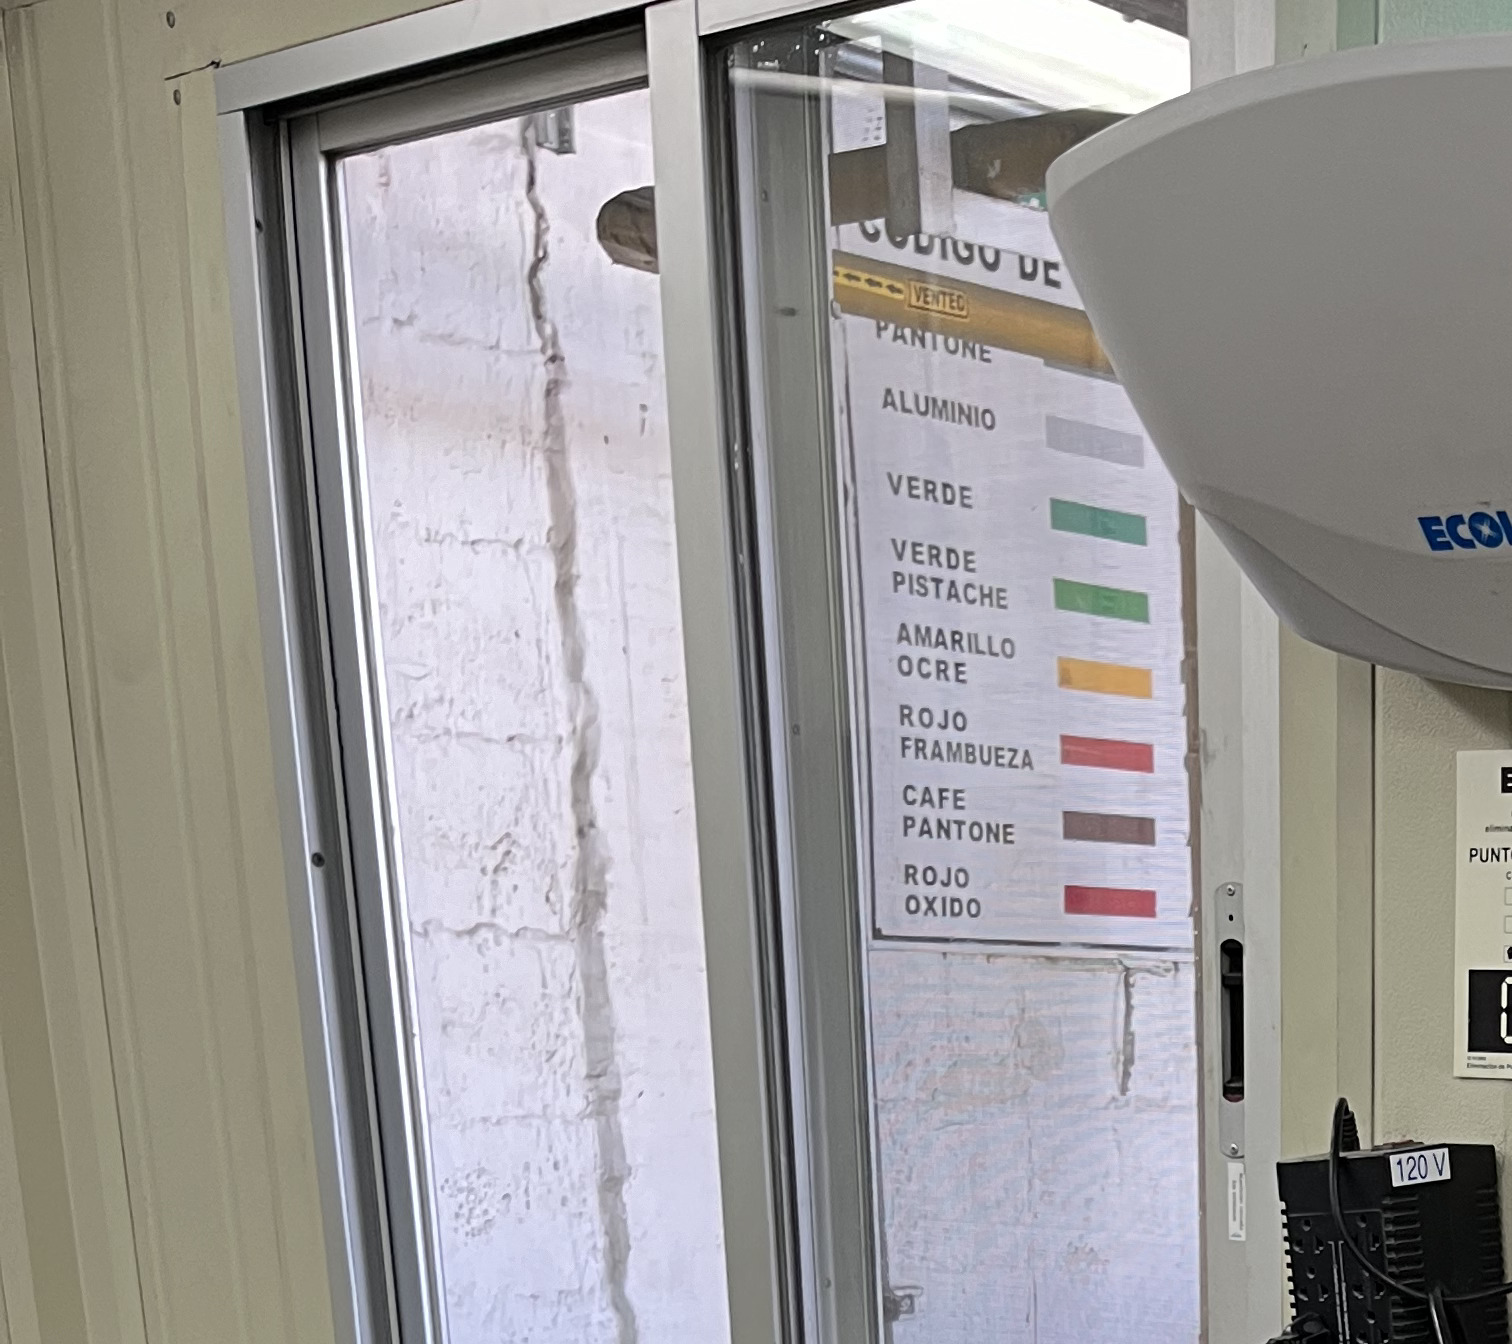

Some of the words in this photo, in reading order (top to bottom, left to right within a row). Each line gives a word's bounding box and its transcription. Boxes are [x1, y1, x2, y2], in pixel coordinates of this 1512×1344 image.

[881, 387, 997, 432] ALUMINIO
[886, 472, 974, 510] VERDE
[890, 537, 978, 574] VERDE
[892, 570, 1009, 610] PISTACHE
[896, 622, 1016, 660] AMARILLO
[897, 655, 969, 684] OCRE
[899, 704, 969, 732] ROJO
[900, 736, 1035, 771] FRAMBUEZA
[902, 784, 967, 811] CAFE
[902, 816, 1016, 845] PANTONE
[904, 863, 970, 888] ROJO
[904, 894, 982, 919] OXIDO
[1396, 1155, 1428, 1182] 120
[1432, 1152, 1446, 1177] V
